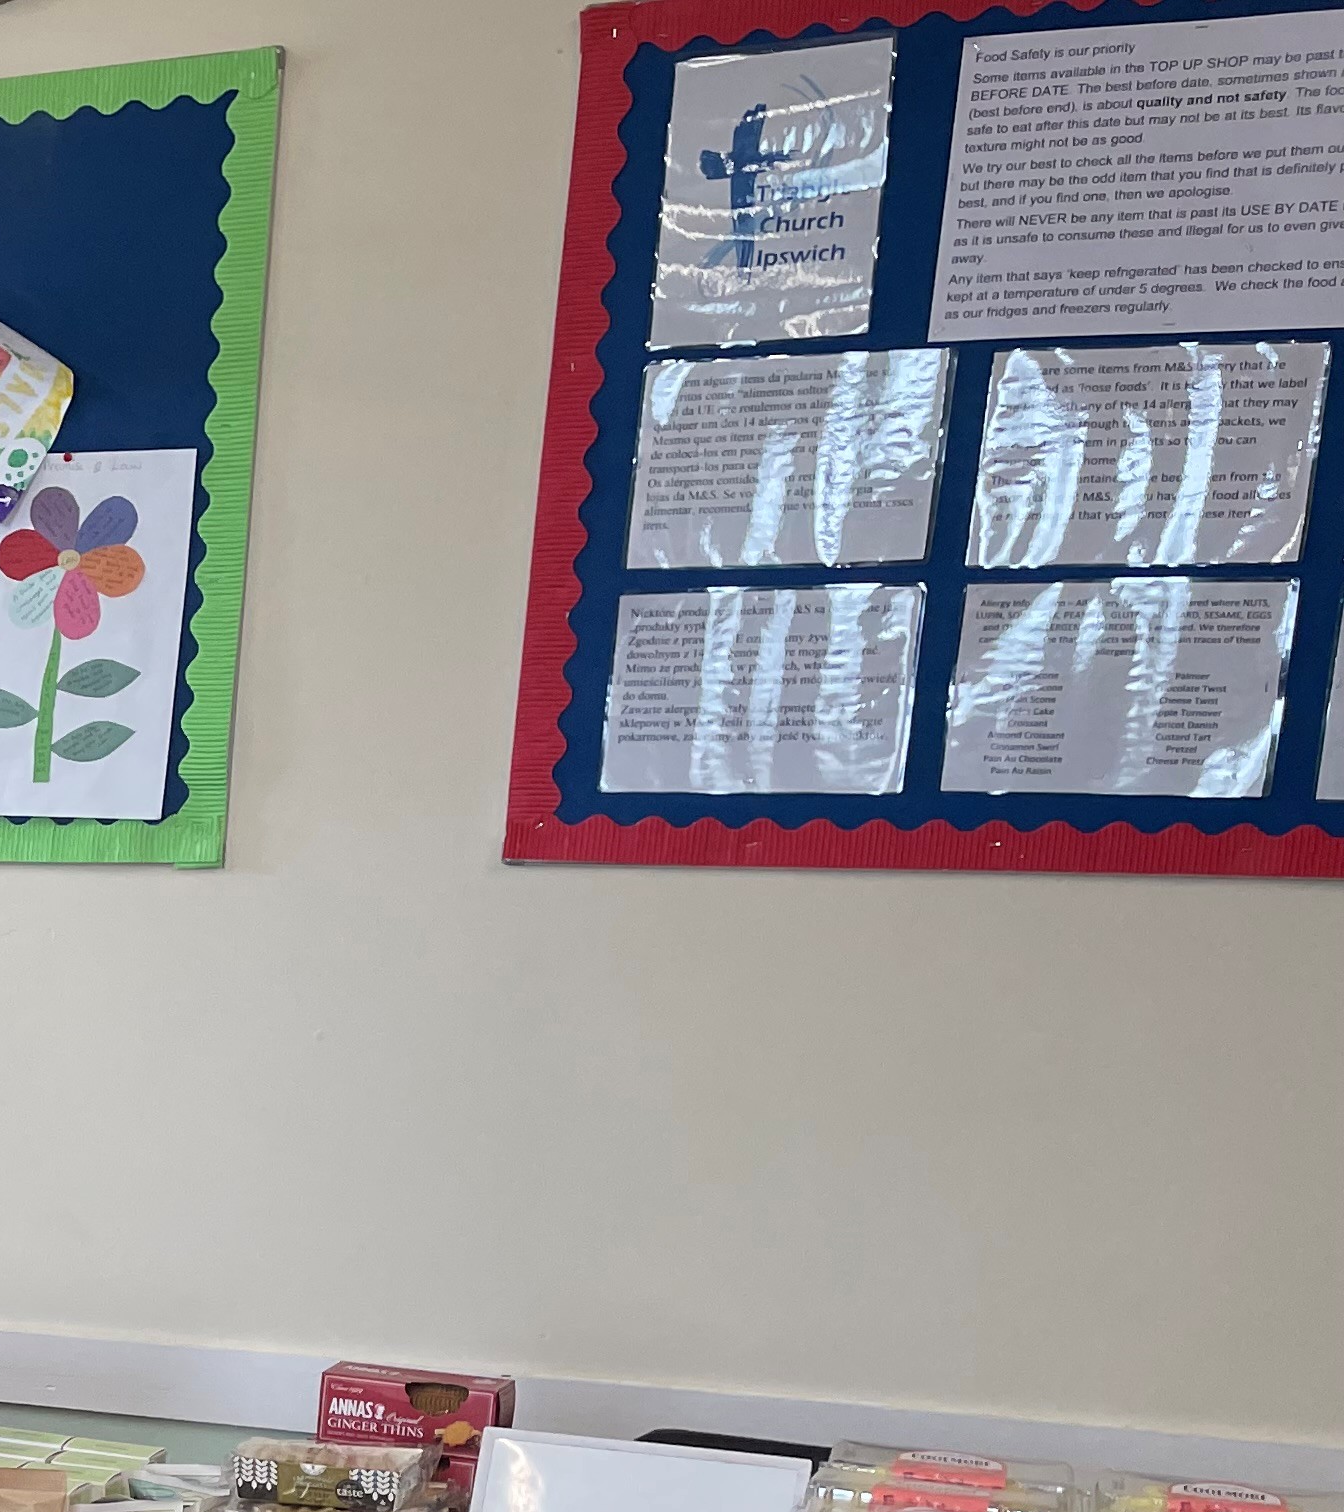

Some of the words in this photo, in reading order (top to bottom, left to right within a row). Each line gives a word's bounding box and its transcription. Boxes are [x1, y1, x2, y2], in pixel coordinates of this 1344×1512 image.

[975, 50, 1008, 63] Food
[1010, 48, 1051, 62] Safety
[1053, 47, 1065, 58] is
[1067, 46, 1091, 57] our
[1092, 42, 1136, 58] priority
[972, 72, 1010, 85] Some
[1012, 71, 1047, 82] items
[1050, 65, 1106, 79] available
[1109, 64, 1121, 75] in
[1124, 61, 1145, 74] the
[1149, 59, 1179, 72] TOP
[1182, 58, 1204, 71] UP
[1206, 55, 1250, 69] SHOP
[1252, 55, 1282, 67] may
[1284, 51, 1302, 64] be
[1305, 49, 1335, 64] past
[1136, 96, 1184, 111] quality
[1186, 93, 1213, 106] and
[1216, 92, 1240, 104] not
[760, 211, 845, 233] Church
[956, 218, 992, 230] There
[995, 215, 1016, 227] will
[1018, 212, 1067, 226] NEVER
[1070, 212, 1087, 224] be
[1090, 213, 1115, 225] any
[1117, 211, 1145, 222] item
[1148, 208, 1172, 220] that
[1175, 210, 1187, 219] is
[1190, 207, 1219, 221] past
[1221, 206, 1237, 217] its
[1240, 203, 1271, 217] USE
[1274, 202, 1296, 215] BY
[1298, 199, 1339, 214] DATE
[756, 244, 846, 271] Ipswich
[1063, 366, 1095, 375] some
[1097, 363, 1130, 374] items
[1133, 362, 1162, 373] from
[1164, 362, 1194, 372] M&S
[1239, 360, 1263, 371] that
[1230, 379, 1255, 389] that
[1258, 381, 1275, 389] we
[1278, 377, 1308, 388] label
[328, 1397, 374, 1419] ANNAS
[327, 1417, 378, 1433] GINGER
[381, 1423, 424, 1439] THINS
[336, 1485, 364, 1498] taste
